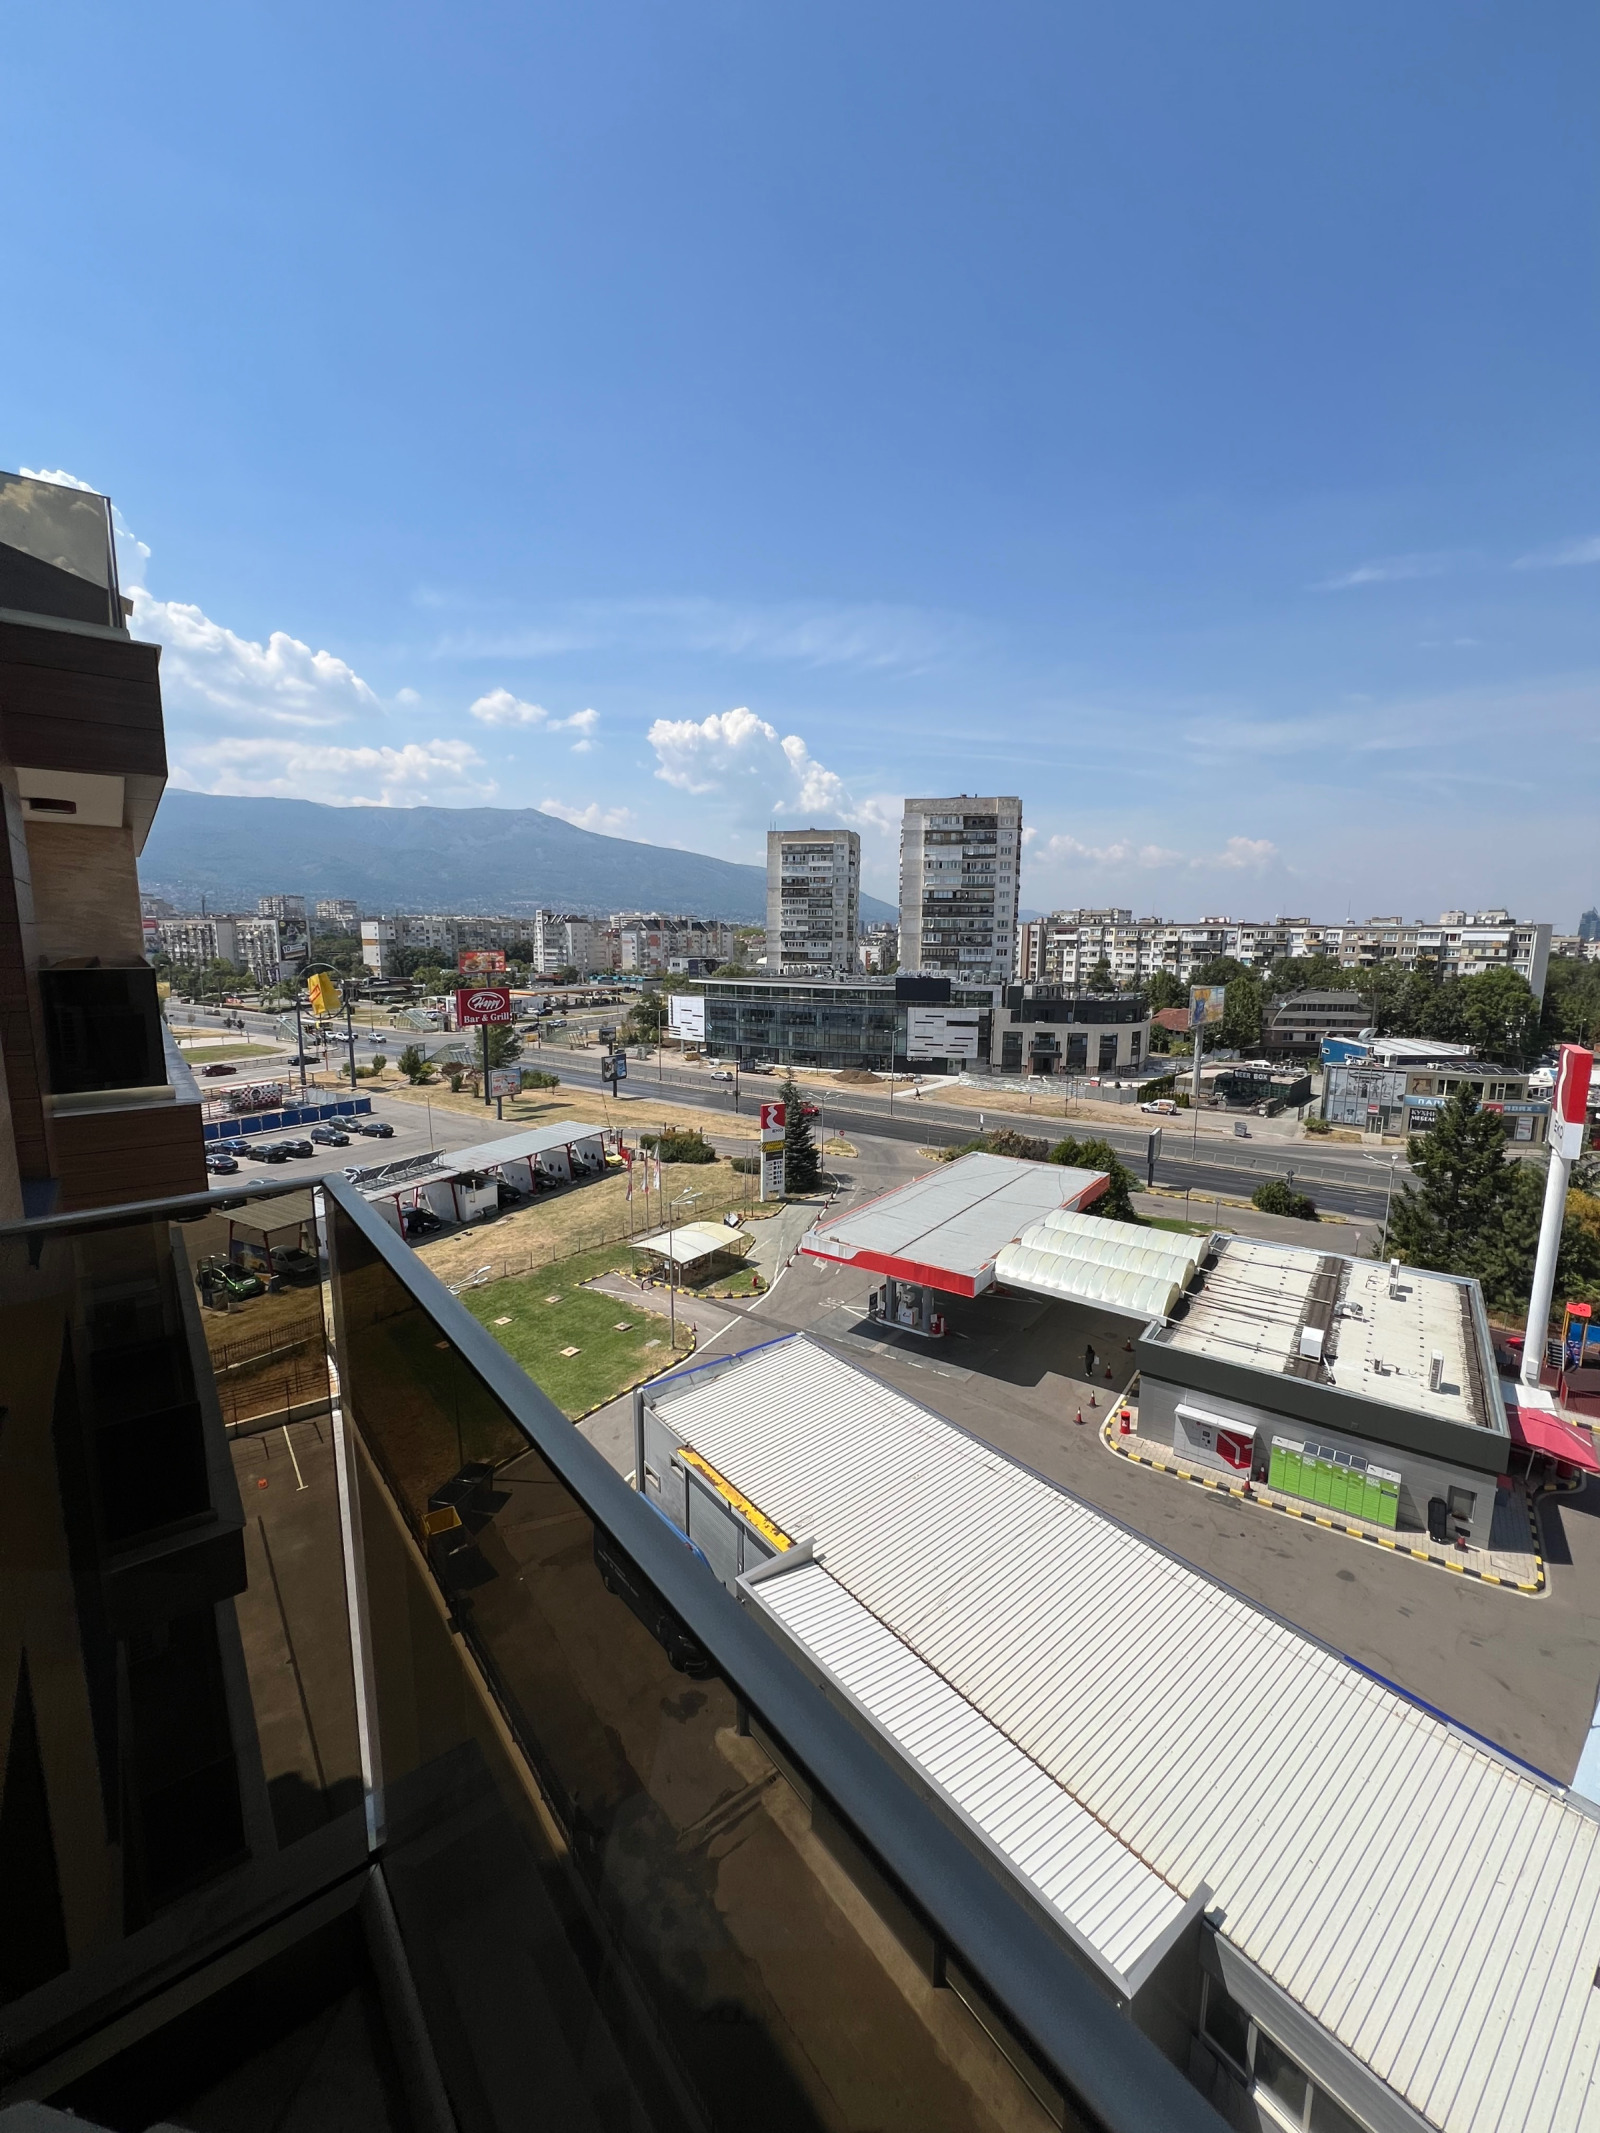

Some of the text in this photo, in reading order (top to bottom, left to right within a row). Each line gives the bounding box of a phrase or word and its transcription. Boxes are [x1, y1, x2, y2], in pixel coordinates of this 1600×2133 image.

[471, 996, 501, 1010] Happy
[463, 1011, 510, 1024] Bar & Grill
